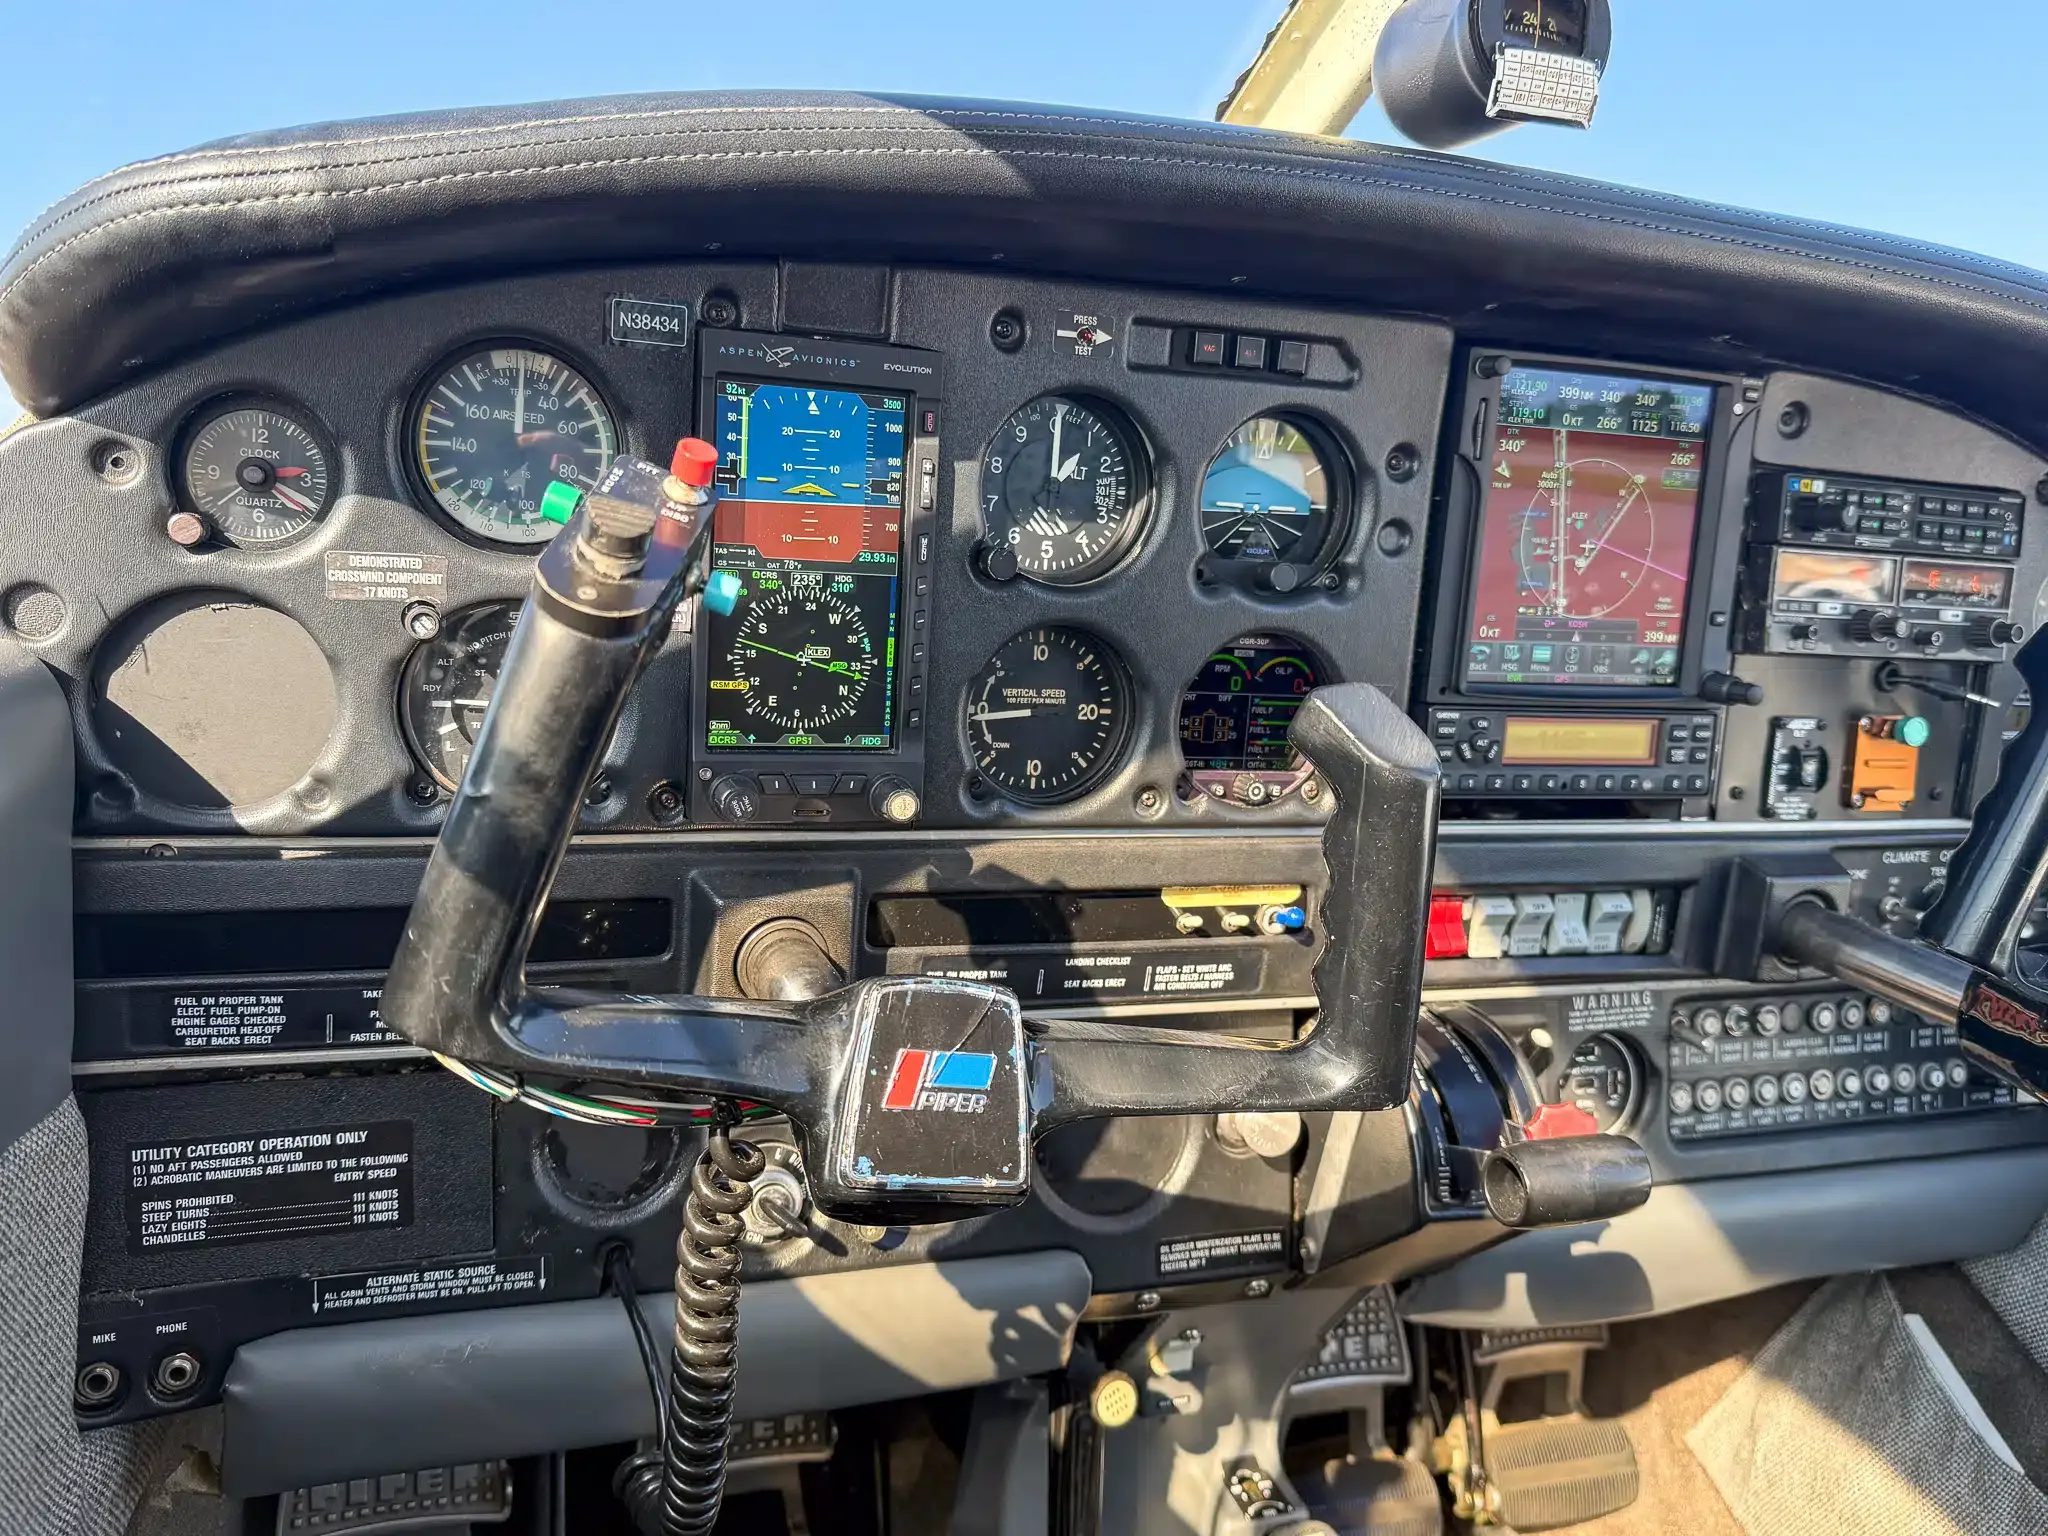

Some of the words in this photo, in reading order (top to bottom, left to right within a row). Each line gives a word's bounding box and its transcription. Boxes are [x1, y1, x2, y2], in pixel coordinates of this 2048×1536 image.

[620, 311, 680, 333] N38434
[1073, 314, 1098, 326] PRESS
[719, 346, 763, 358] ASPEN
[1074, 345, 1093, 356] TEST
[883, 362, 932, 375] EVOLUTION
[1558, 386, 1580, 400] 399
[538, 397, 560, 411] 40
[883, 398, 902, 410] 3500
[465, 404, 490, 420] 160
[492, 410, 545, 425] AIRSEED
[1512, 407, 1545, 419] 119.10
[557, 422, 578, 436] 60
[884, 422, 903, 433] 1000
[1632, 419, 1659, 433] 1125
[1670, 420, 1701, 433] 116.50
[252, 428, 269, 444] 12
[1016, 426, 1028, 443] 9
[452, 438, 477, 454] 140
[240, 448, 280, 459] CLOCK
[887, 458, 901, 467] 900
[991, 457, 1003, 474] 8
[559, 464, 578, 480] 80
[235, 496, 283, 508] QUARTZ
[885, 523, 898, 532] 700
[1041, 541, 1053, 558] 5
[348, 555, 423, 570] DEMONSTRATED
[327, 569, 385, 583] CROSSWIND
[386, 572, 443, 585] COMPONENT
[793, 574, 821, 587] 235°
[835, 575, 853, 583] HDG
[759, 579, 783, 590] 340°
[831, 582, 854, 593] 310°
[363, 586, 377, 598] 17
[377, 587, 409, 599] KNOTS
[480, 632, 507, 646] PITCH
[1239, 637, 1270, 646] CGR-30P
[808, 649, 829, 657] KLEX
[1033, 645, 1049, 661] 10
[1214, 664, 1231, 673] RPM
[423, 684, 441, 692] RDY
[1002, 688, 1039, 697] VERTICAL
[1041, 689, 1066, 698] SPEED
[1078, 704, 1098, 720] 20
[788, 736, 813, 745] GPS1
[861, 736, 882, 745] HDG
[1882, 850, 1930, 864] CLIMATE
[1066, 957, 1095, 966] LANDING
[1096, 956, 1132, 966] CHECKLIST
[959, 971, 987, 980] PROPER
[990, 970, 1007, 979] TANK
[1156, 966, 1177, 974] FLAPS
[1182, 965, 1194, 973] SET
[1218, 964, 1232, 972] ARC
[1064, 980, 1080, 988] SEAT
[1082, 979, 1103, 988] BACKS
[1105, 978, 1126, 987] ERECT
[1154, 982, 1164, 990] AIR
[1166, 981, 1208, 990] CONDITIONER
[1210, 980, 1224, 988] OFF
[174, 997, 199, 1006] FUEL
[202, 997, 216, 1006] ON
[220, 996, 256, 1005] PROPER
[260, 996, 284, 1004] TANK
[1572, 990, 1652, 1010] WARNING
[177, 1007, 207, 1016] ELECT.
[210, 1006, 234, 1015] FUEL
[238, 1006, 280, 1014] PUMP-ON
[171, 1017, 206, 1026] ENGINE
[209, 1016, 240, 1026] GAGES
[244, 1016, 286, 1024] CHECKED
[175, 1026, 237, 1036] CARBURETOR
[240, 1026, 282, 1035] HEAT-OFF
[350, 1032, 382, 1042] FASTEN
[184, 1037, 208, 1046] SEAT
[211, 1036, 242, 1045] BACKS
[244, 1036, 272, 1044] ERECT
[916, 1091, 988, 1113] PIPER
[131, 1147, 182, 1162] UTILITY
[187, 1140, 255, 1157] CATEGORY
[259, 1134, 332, 1151] OPERATION
[336, 1131, 368, 1143] ONLY
[133, 1165, 146, 1176] (1)
[150, 1163, 164, 1174] NO
[168, 1161, 187, 1172] AFT
[190, 1156, 254, 1170] PASSENGERS
[258, 1152, 303, 1164] ALLOWED
[133, 1176, 148, 1187] (2)
[151, 1172, 202, 1186] ACROBATIC
[206, 1167, 263, 1181] MANEUVERS
[266, 1164, 285, 1175] ARE
[287, 1160, 324, 1172] LIMITED
[326, 1158, 338, 1170] TO
[340, 1158, 358, 1168] THE
[360, 1154, 409, 1166] FOLLOWING
[334, 1171, 364, 1183] ENTRY
[368, 1168, 398, 1180] SPEED
[142, 1201, 172, 1212] SPINS
[176, 1194, 234, 1209] PROHIBITED
[142, 1211, 172, 1223] STEEP
[176, 1208, 210, 1220] TURNS
[353, 1192, 366, 1202] 111
[369, 1189, 399, 1200] KNOTS
[142, 1223, 168, 1234] LAZY
[172, 1219, 207, 1231] EIGHTS
[353, 1204, 366, 1214] 111
[369, 1200, 399, 1212] KNOTS
[142, 1230, 206, 1246] CHANDELLES
[354, 1215, 366, 1224] 111
[369, 1211, 399, 1223] KNOTS
[366, 1272, 420, 1288] ALTERNATE
[423, 1269, 454, 1282] STATIC
[458, 1264, 496, 1278] SOURCE
[324, 1292, 338, 1300] ALL
[340, 1288, 364, 1298] CABIN
[366, 1286, 390, 1296] VENTS
[392, 1284, 408, 1293] AND
[410, 1282, 435, 1292] STORM
[438, 1279, 470, 1289] WINDOW
[472, 1276, 493, 1286] MUST
[495, 1274, 504, 1283] BE
[506, 1271, 536, 1281] CLOSED.
[324, 1299, 353, 1309] HEATER
[355, 1297, 371, 1306] AND
[373, 1292, 416, 1304] DEFROSTER
[418, 1290, 438, 1300] MUST
[440, 1289, 450, 1298] BE
[467, 1284, 486, 1294] PULL
[488, 1283, 502, 1292] AFT
[504, 1282, 512, 1290] TO
[156, 1322, 188, 1334] PHONE
[92, 1333, 116, 1344] MIKE
